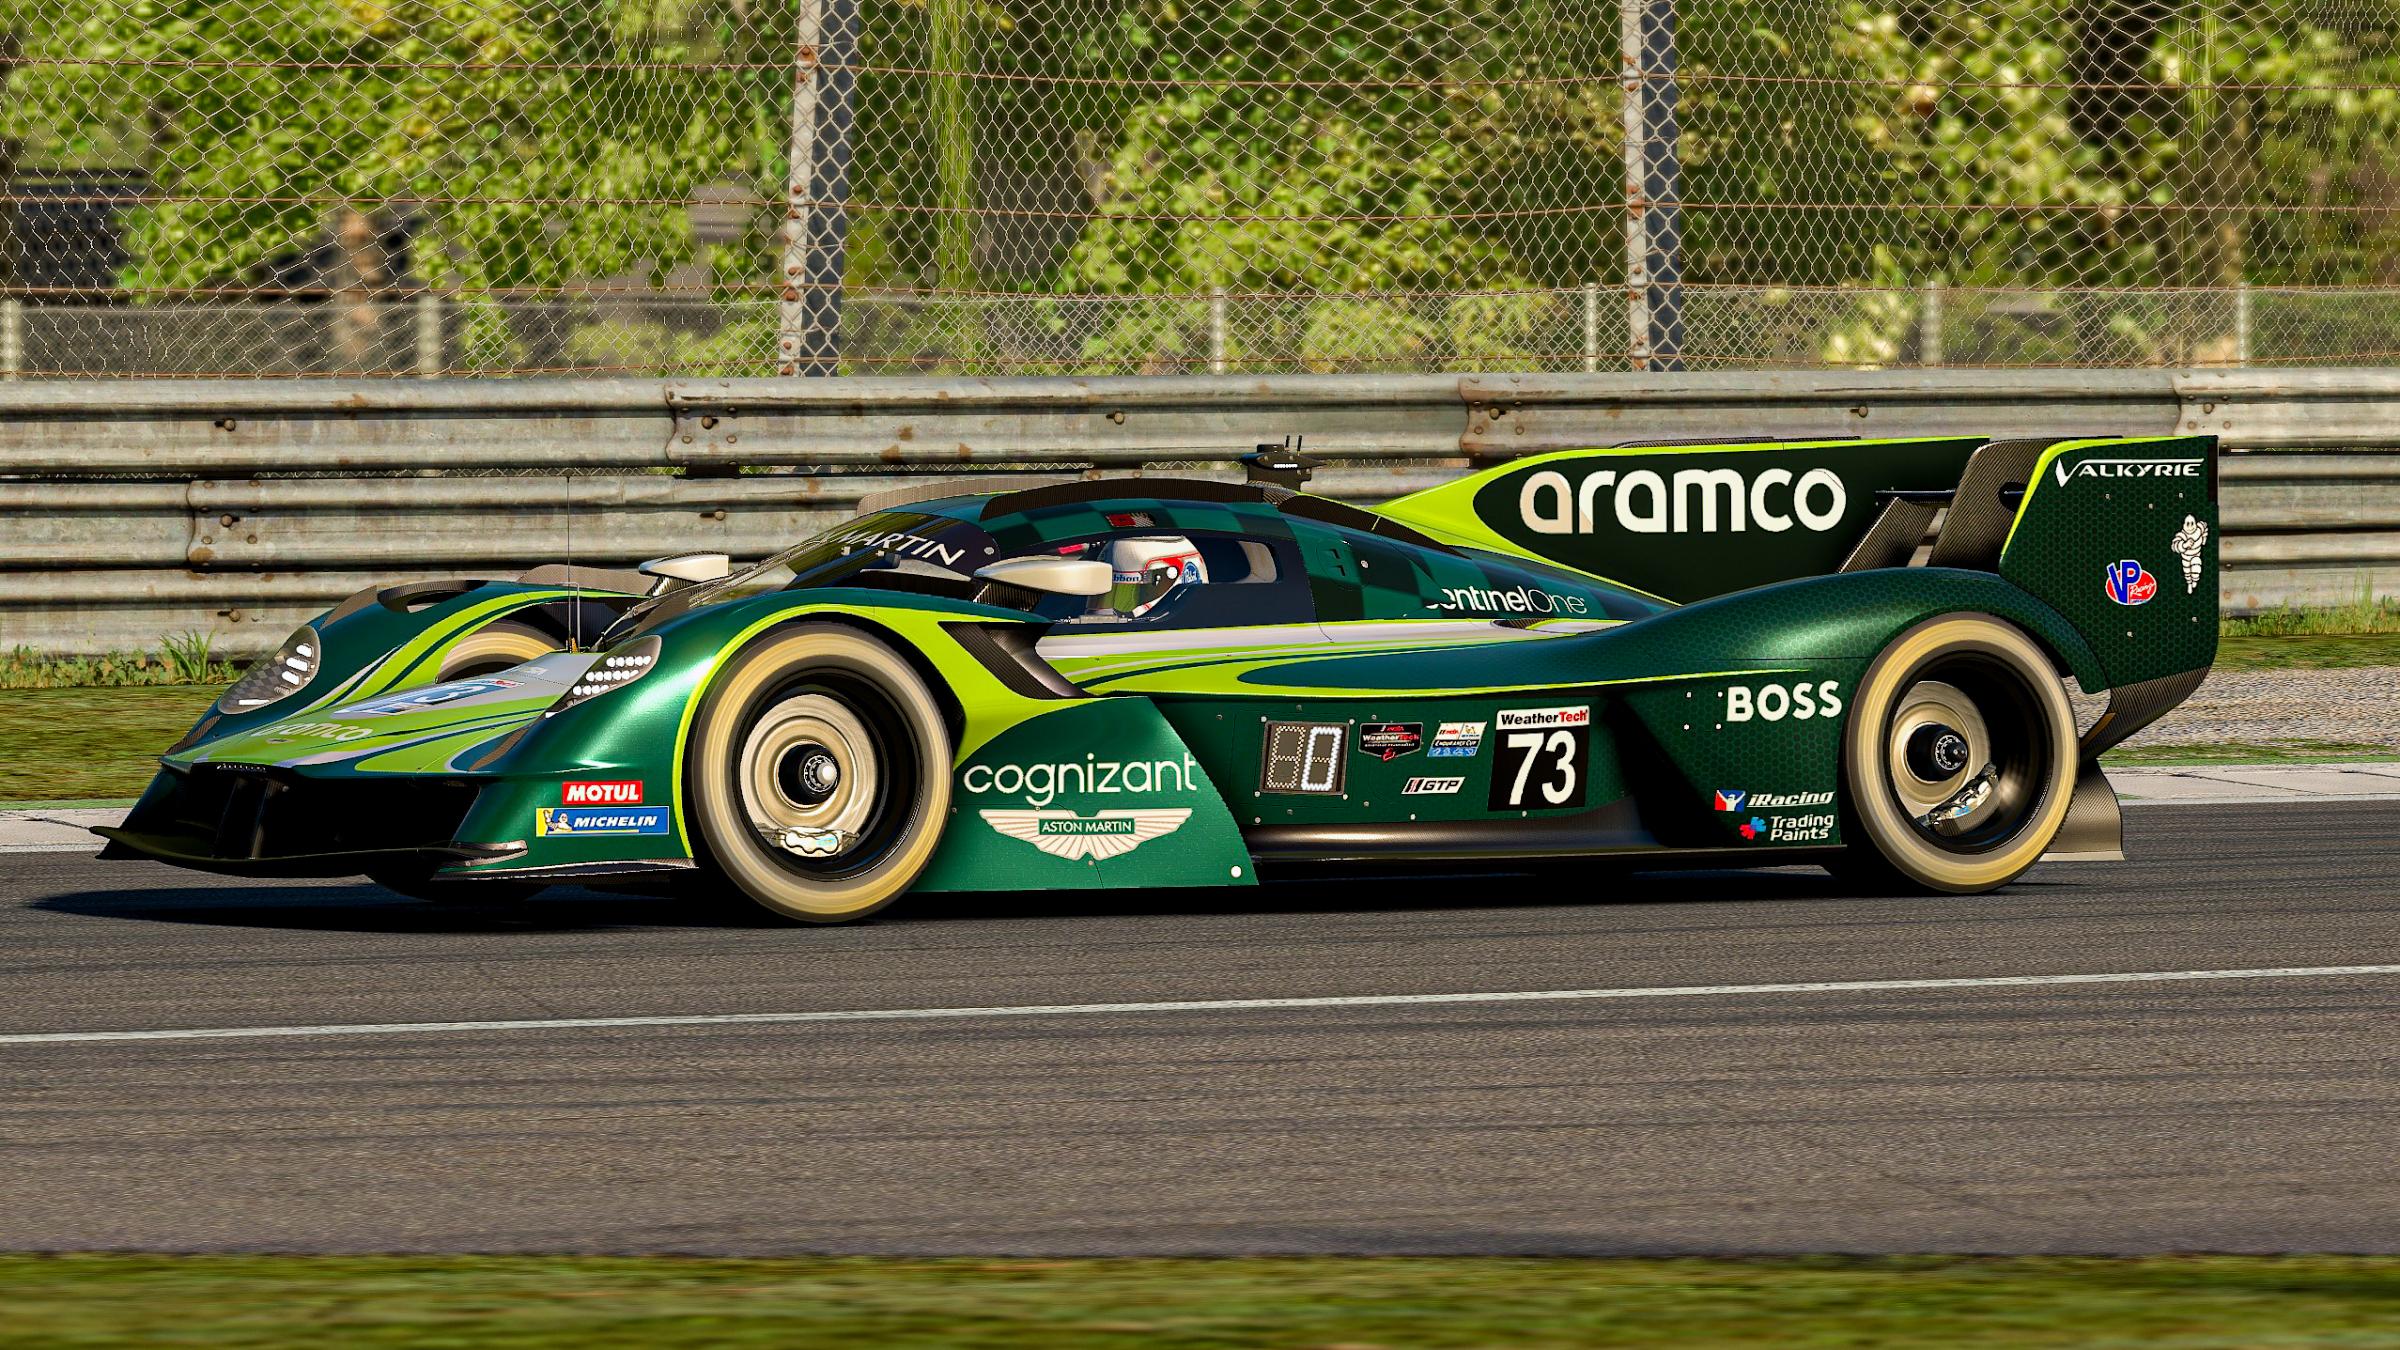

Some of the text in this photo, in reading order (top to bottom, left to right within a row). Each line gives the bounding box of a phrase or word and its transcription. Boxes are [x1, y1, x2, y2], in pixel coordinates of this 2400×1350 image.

[2055, 458, 2205, 488] VALKYRIE
[1518, 467, 1847, 534] aramco
[2106, 559, 2142, 605] VP
[1726, 680, 1843, 722] BOSS
[1501, 708, 1587, 726] WeatherTech
[1507, 730, 1577, 805] 73
[963, 752, 1198, 807] cognizant
[1421, 779, 1460, 791] GTP
[566, 783, 640, 802] MOTUL
[1746, 790, 1836, 808] iRacing
[573, 815, 658, 828] MICHELIN
[1041, 820, 1132, 833] ASTON MARTIN
[1769, 814, 1835, 830] Trading
[1769, 827, 1830, 842] Paints
